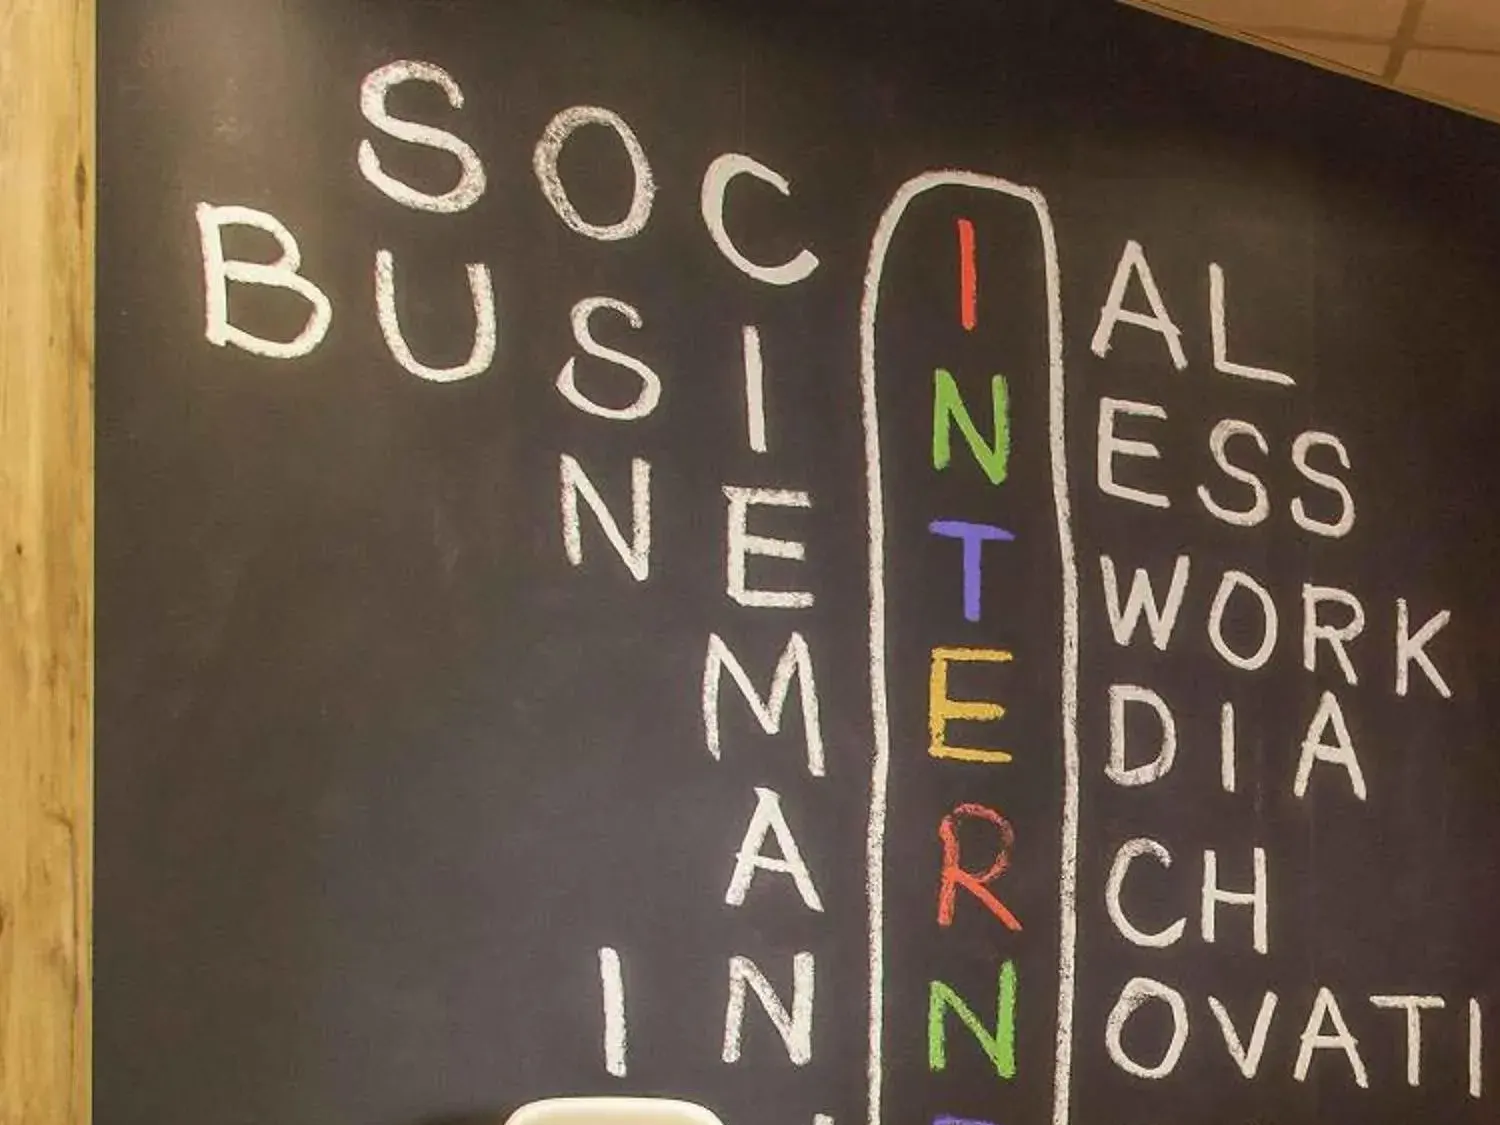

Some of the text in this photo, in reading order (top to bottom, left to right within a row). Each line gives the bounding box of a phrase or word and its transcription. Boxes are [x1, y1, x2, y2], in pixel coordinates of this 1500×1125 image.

[358, 60, 1296, 386] SOCIAL
[193, 201, 1356, 538] BUSINESS
[558, 453, 1452, 698] NETWORK
[701, 631, 1367, 801] MEDIA
